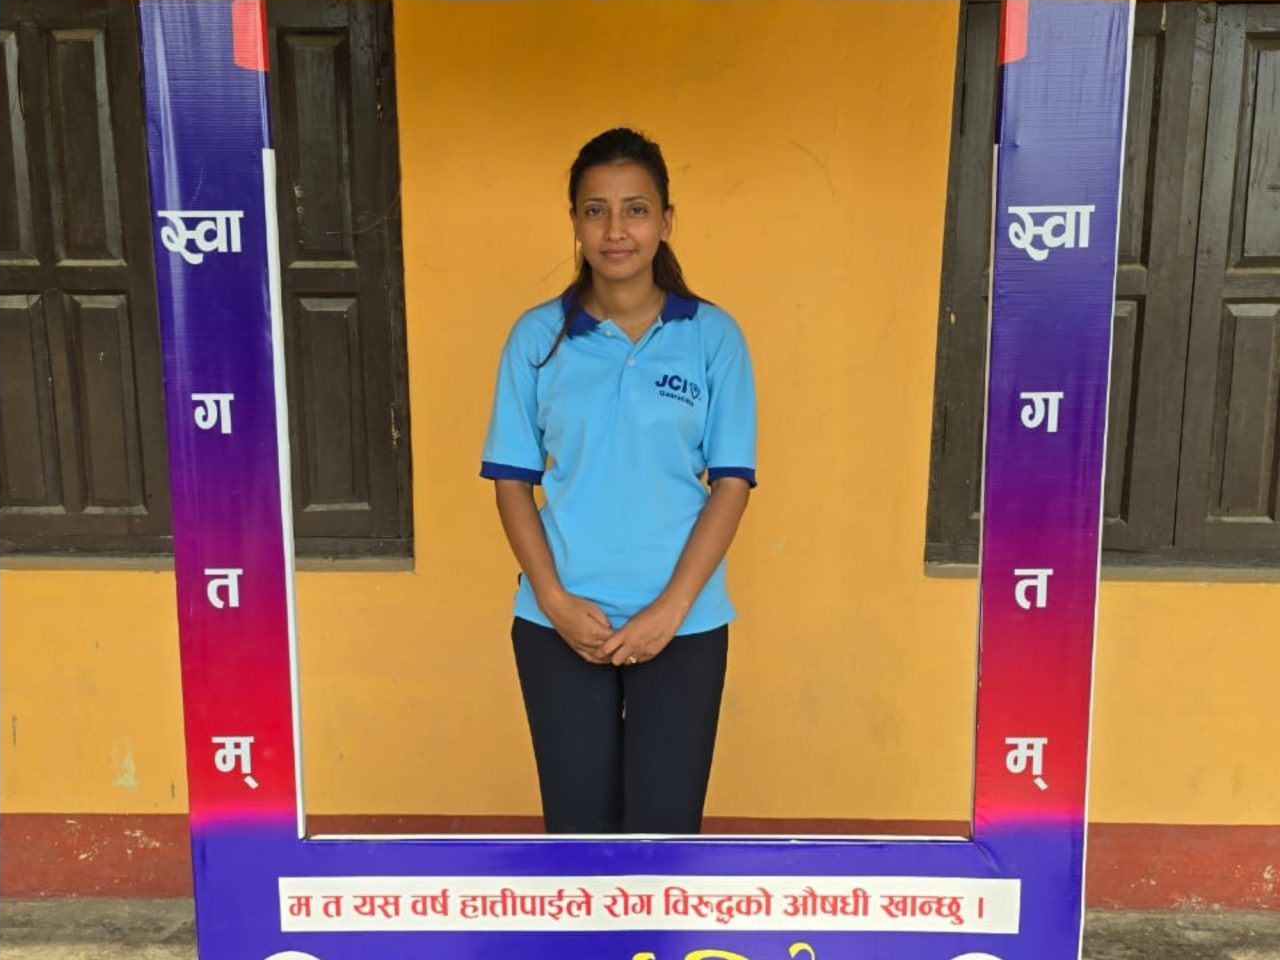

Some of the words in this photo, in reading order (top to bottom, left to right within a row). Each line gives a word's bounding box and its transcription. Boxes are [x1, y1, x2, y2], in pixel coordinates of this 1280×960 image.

[654, 374, 688, 394] JCI
[288, 895, 313, 918] म
[322, 895, 343, 918] त
[352, 895, 401, 918] यस
[411, 888, 450, 918] वर्ष
[603, 886, 655, 919] रोग
[782, 886, 870, 918] औषधी
[880, 895, 965, 925] खान्छु
